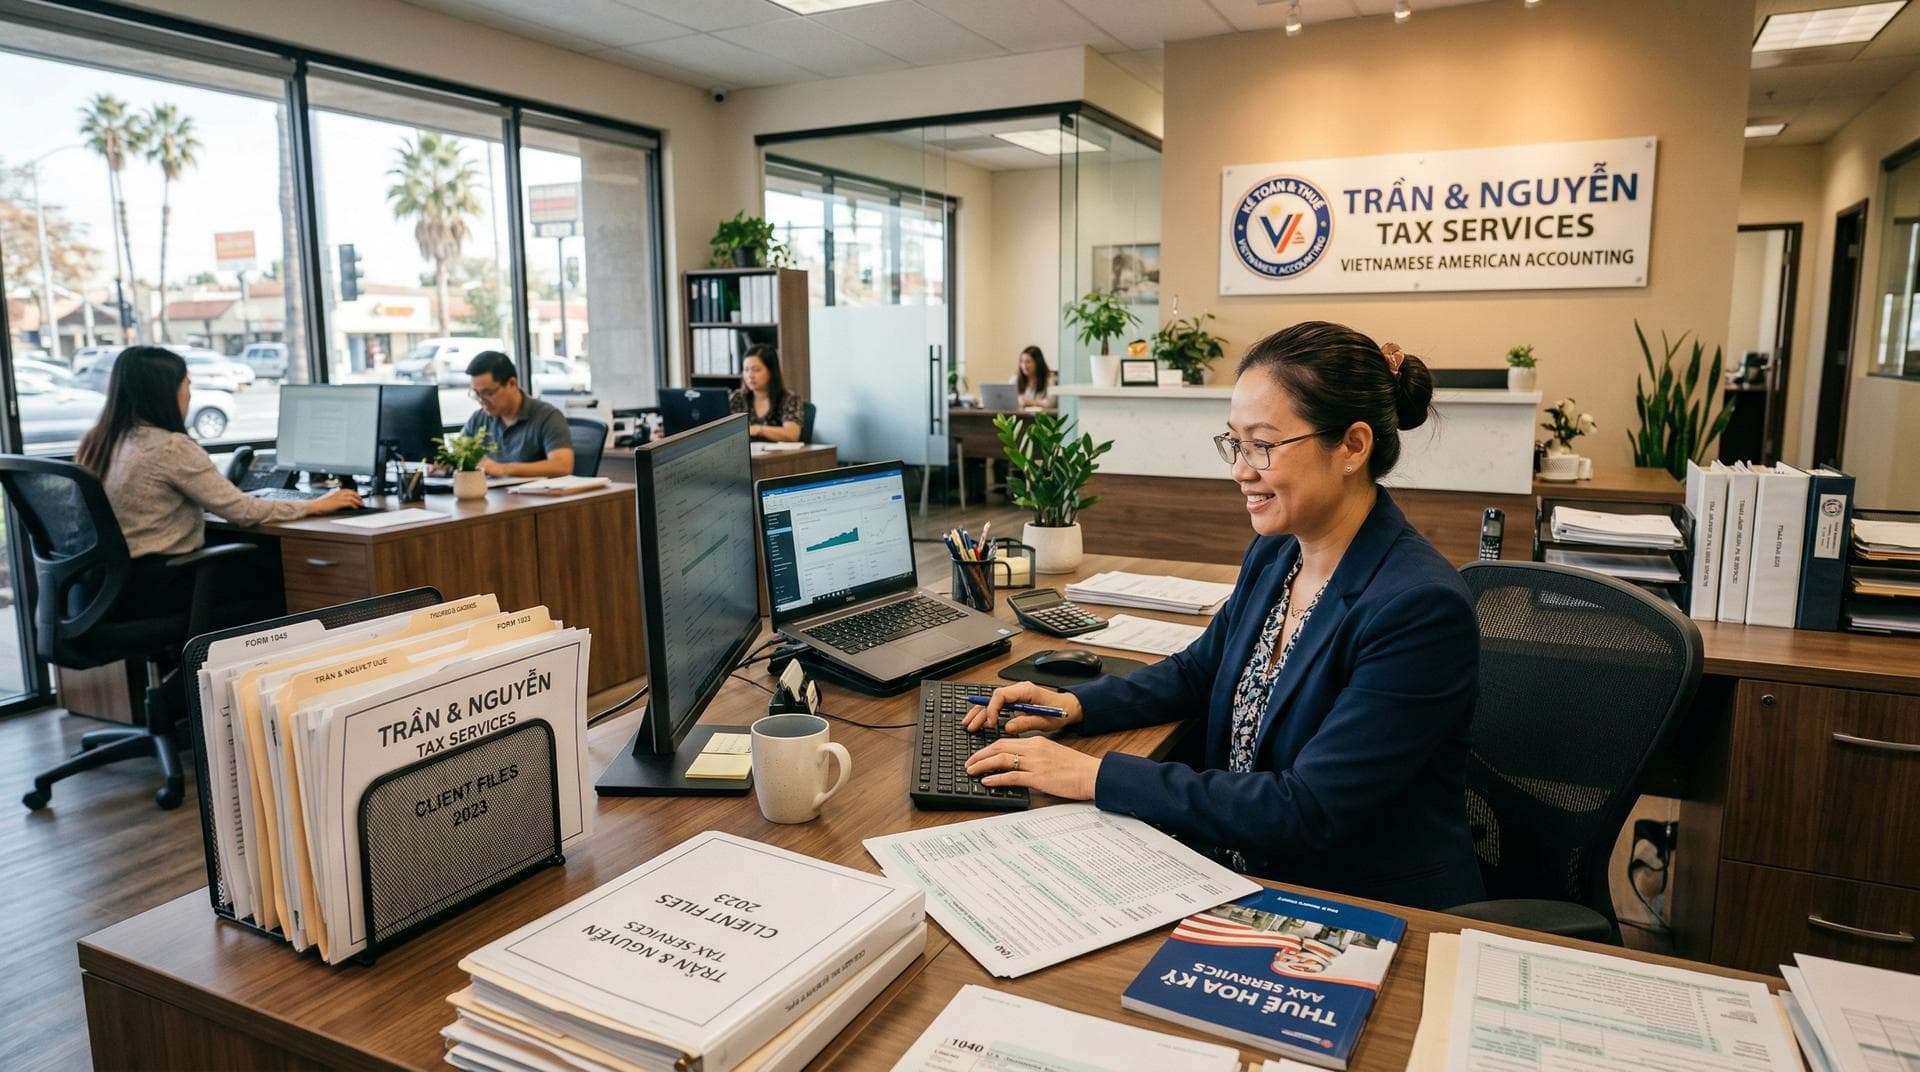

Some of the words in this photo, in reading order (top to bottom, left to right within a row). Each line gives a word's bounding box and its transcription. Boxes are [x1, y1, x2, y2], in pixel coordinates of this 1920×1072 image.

[1287, 181, 1297, 193] &
[1343, 176, 1433, 214] TRẦN
[1445, 184, 1469, 210] &
[1480, 162, 1638, 209] NGUYỄN
[1376, 220, 1433, 245] TAX
[1443, 213, 1595, 243] SERVICES
[1341, 255, 1434, 273] VIETNAMESE
[1438, 252, 1521, 270] AMERICAN
[1525, 248, 1635, 268] ACCOUNTING
[497, 620, 516, 630] FORM
[245, 637, 269, 648] FORM
[378, 707, 440, 748] TRẦN
[447, 702, 462, 723] &
[468, 668, 551, 717] NGUYỄN
[416, 736, 445, 758] TAX
[449, 711, 517, 746] SERVICES
[415, 781, 473, 817] CLIENT
[477, 764, 519, 793] FILES
[453, 799, 488, 827] 2023
[655, 894, 710, 917] FILES
[714, 893, 762, 913] 2023
[623, 921, 696, 951] SERVICES
[704, 912, 779, 939] CLIENT
[658, 953, 675, 964] &
[697, 945, 727, 963] TAX
[1192, 963, 1285, 994] SERRVIICS
[1203, 979, 1260, 1006] HOA
[1286, 987, 1326, 1003] AAX
[951, 1038, 984, 1053] 1040
